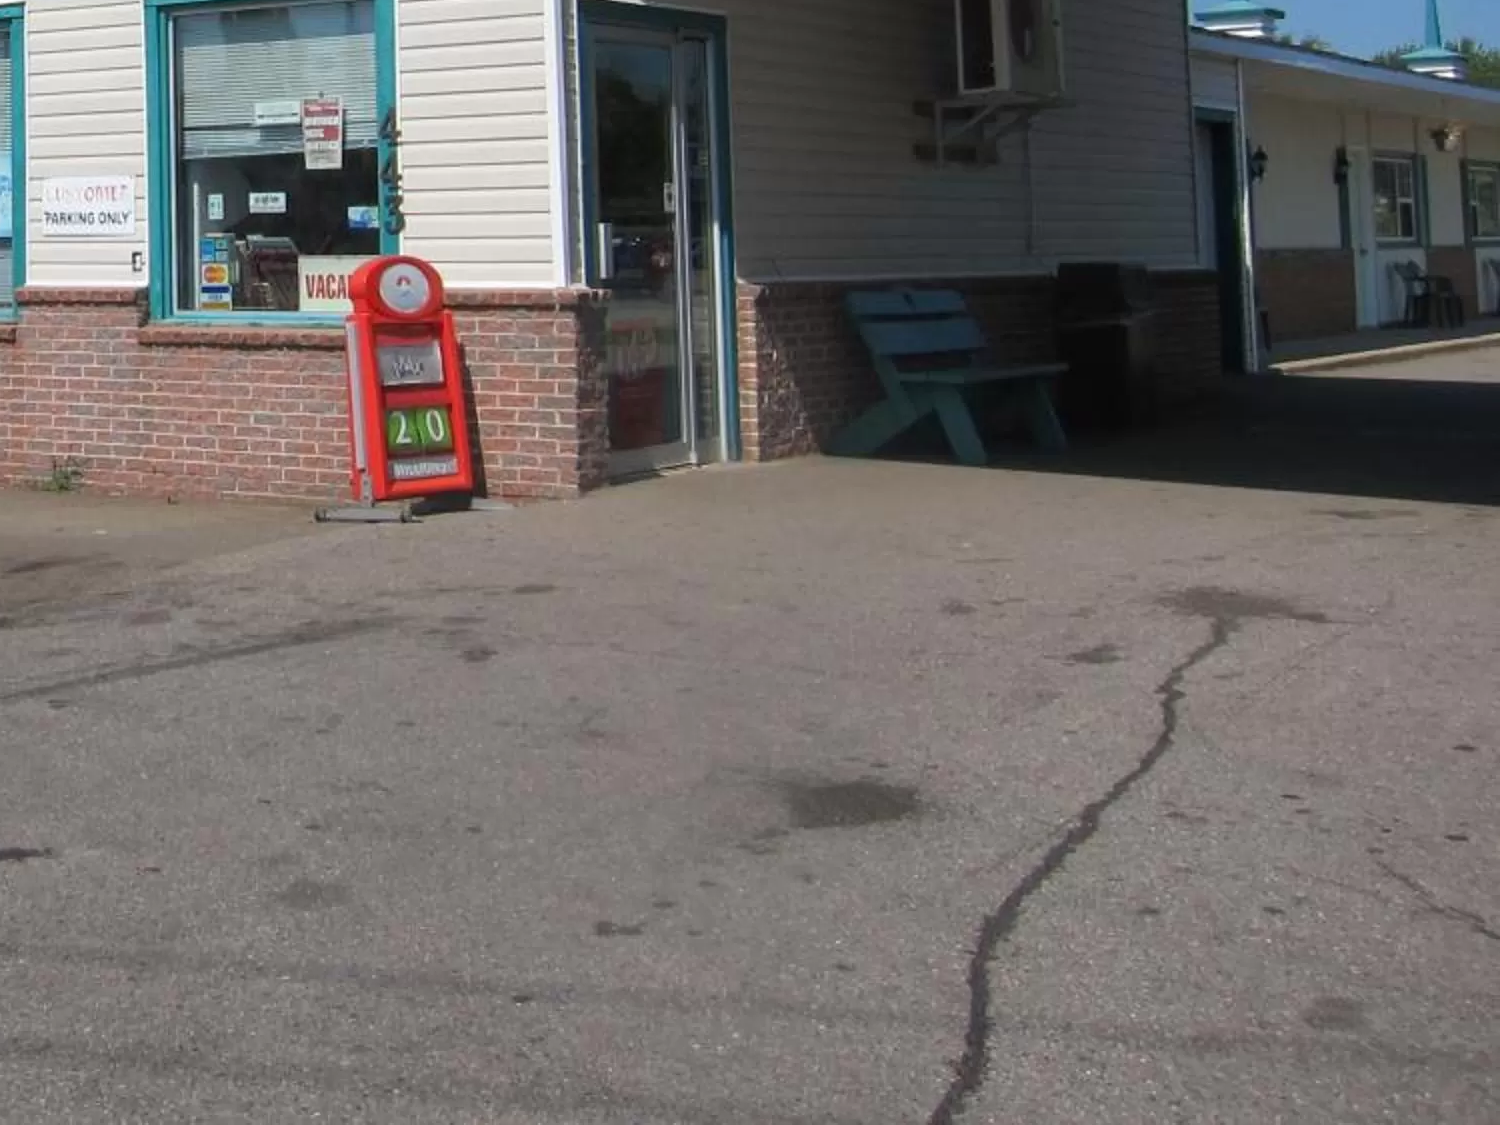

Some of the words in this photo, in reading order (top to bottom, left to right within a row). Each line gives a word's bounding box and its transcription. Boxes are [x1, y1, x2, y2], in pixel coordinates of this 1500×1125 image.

[44, 211, 96, 227] PARKING
[98, 210, 132, 226] ONLY
[305, 274, 350, 300] VACA
